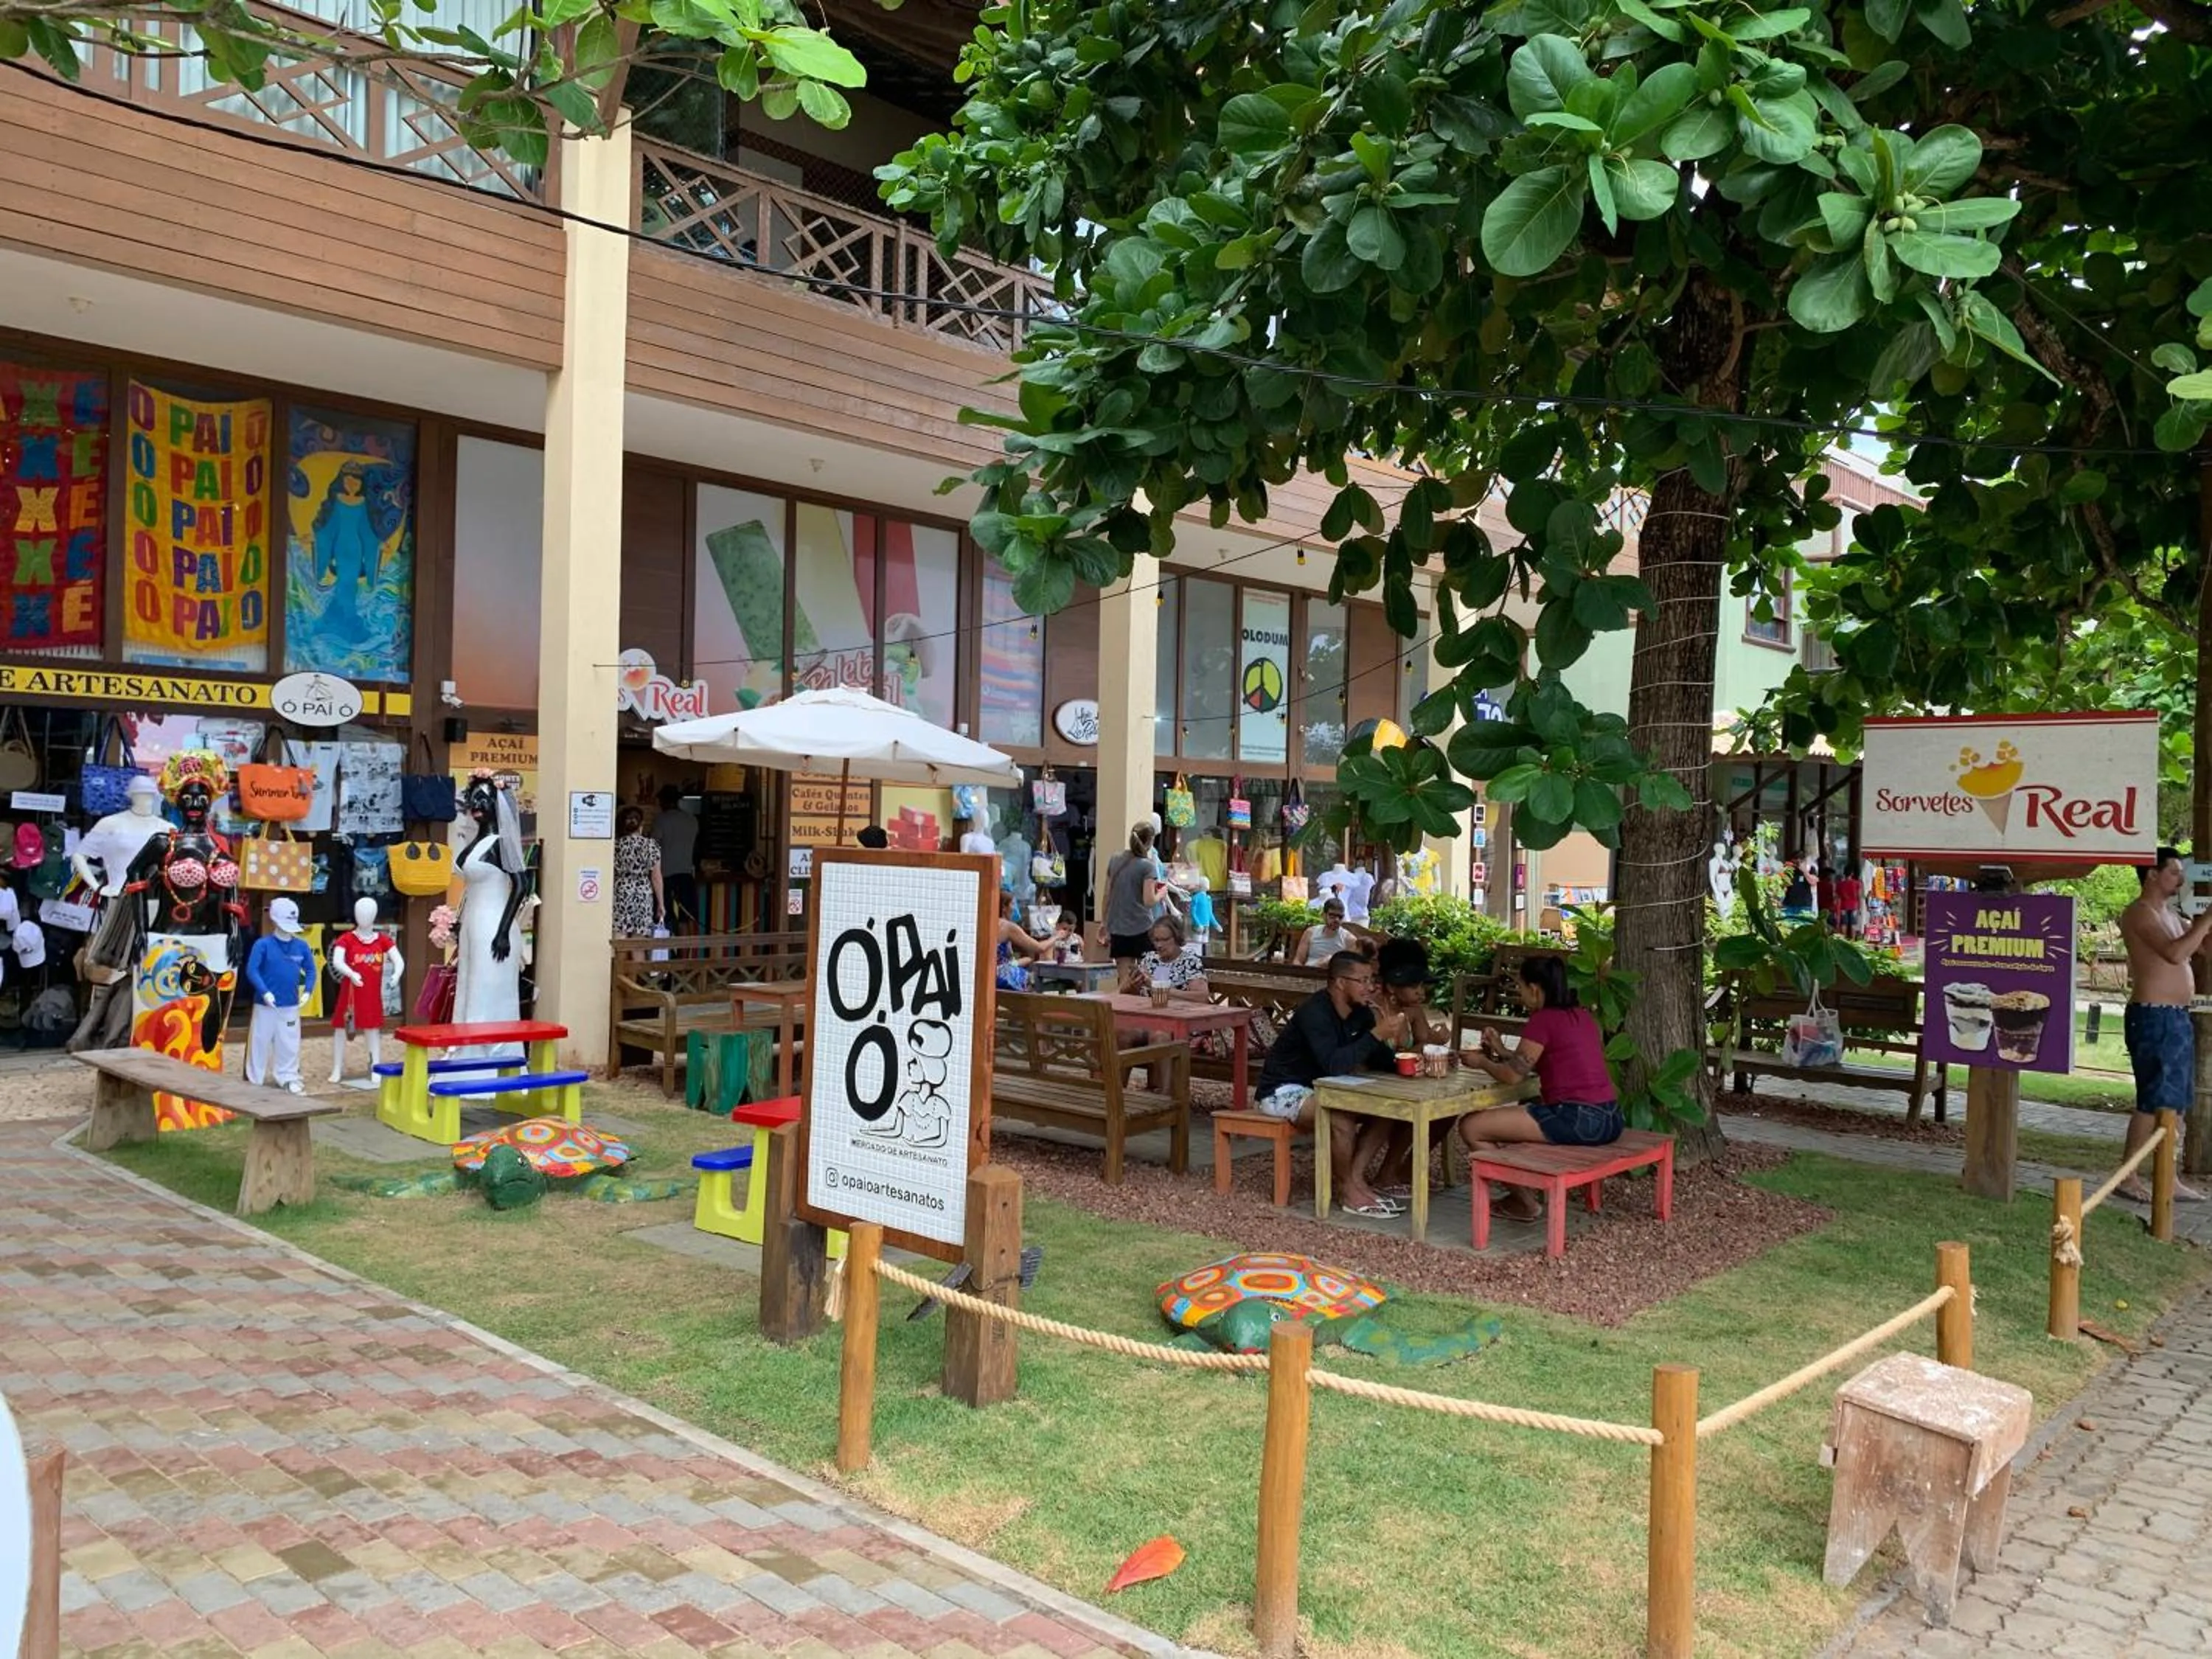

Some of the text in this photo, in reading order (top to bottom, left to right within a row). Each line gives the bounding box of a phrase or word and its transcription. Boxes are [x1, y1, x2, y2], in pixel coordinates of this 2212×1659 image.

[1242, 628, 1290, 647] OLODUM
[25, 671, 257, 705] ARTESANATO
[649, 681, 706, 719] Real
[282, 698, 353, 717] Ó PAÍ Ó
[470, 751, 538, 765] PREMIUM
[487, 737, 526, 754] AÇAÍ
[803, 801, 813, 810] &
[1876, 785, 2141, 838] Sorvetes Real
[1975, 907, 2022, 934] AÇAÍ
[1951, 934, 2045, 959] PREMIUM
[851, 1138, 886, 1153] MERCADO
[899, 1150, 947, 1166] ARTESANATO
[841, 1173, 945, 1211] opaioartesanatos
